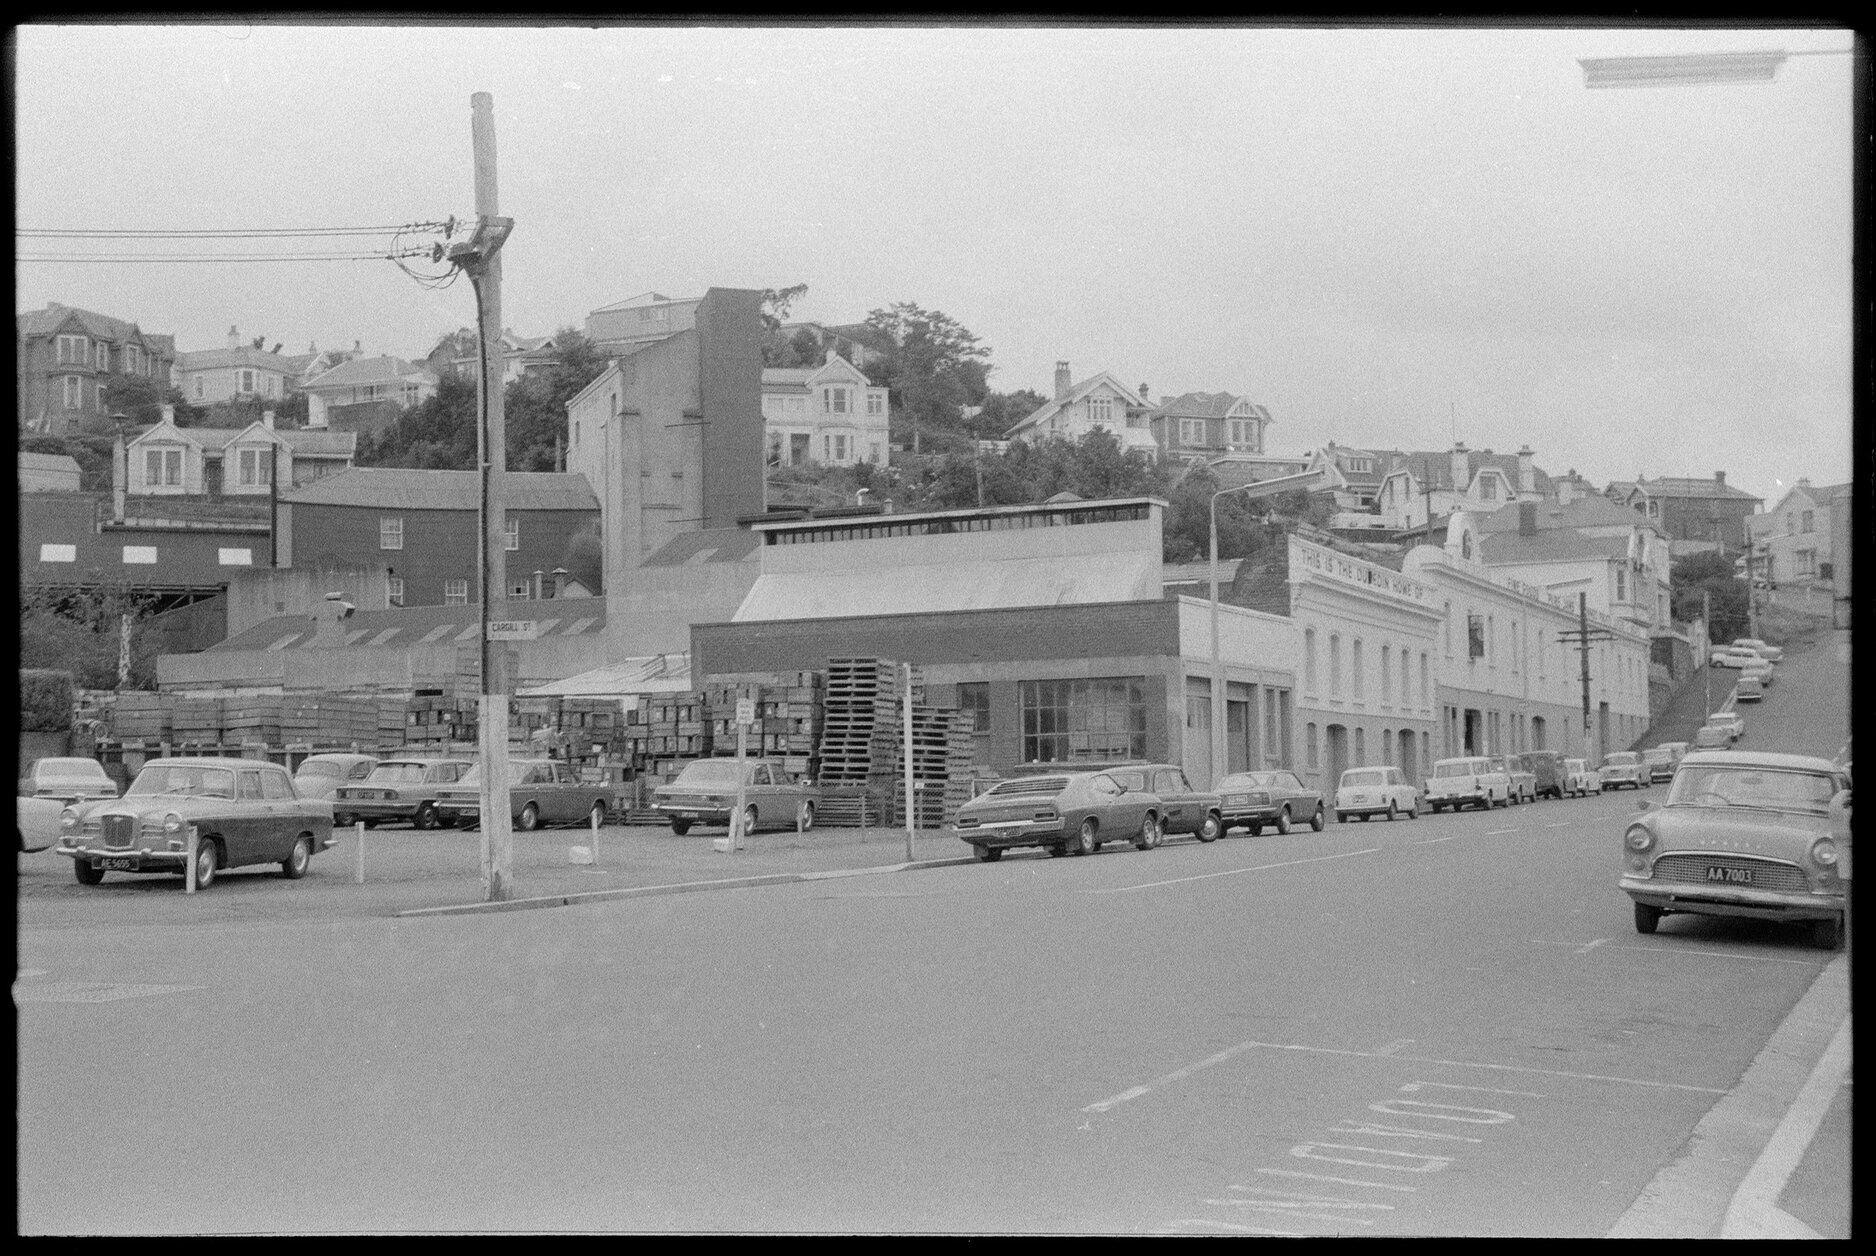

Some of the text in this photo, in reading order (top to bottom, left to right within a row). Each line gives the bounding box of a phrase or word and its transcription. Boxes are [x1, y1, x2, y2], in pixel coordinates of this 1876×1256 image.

[1301, 548, 1423, 600] THIS IS THE DUEDIN HOME OF
[492, 622, 531, 631] CARGILL ST
